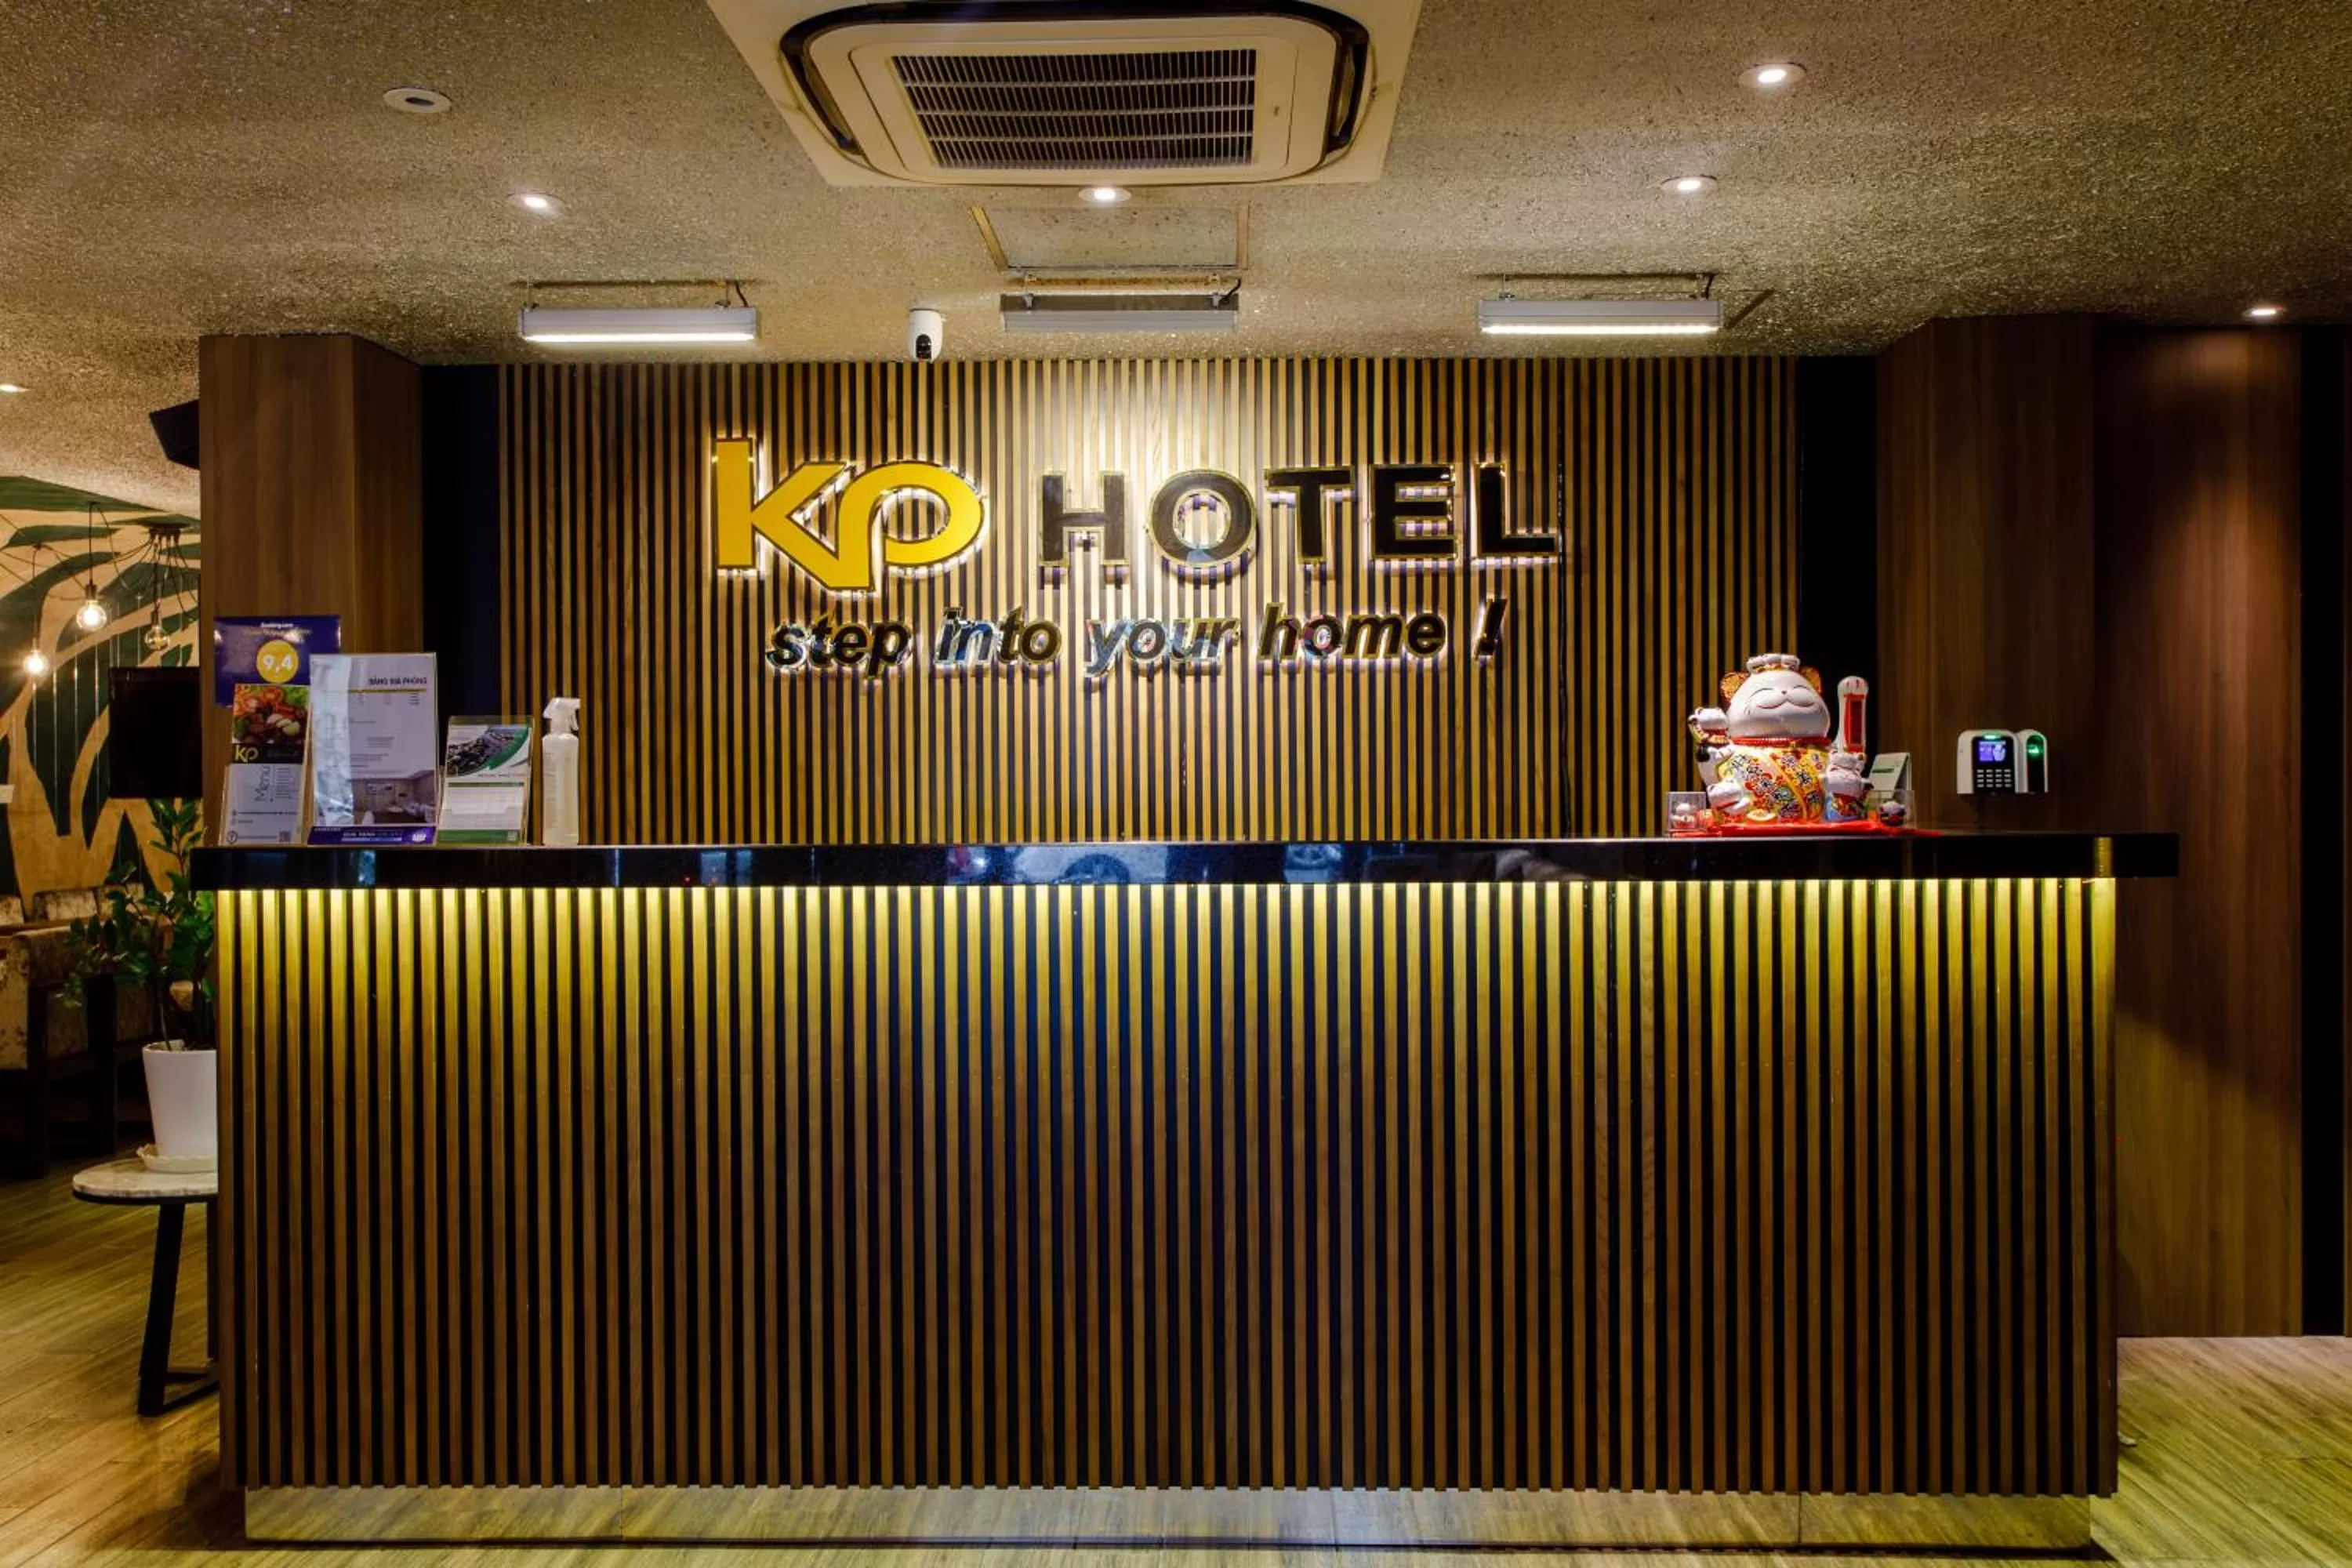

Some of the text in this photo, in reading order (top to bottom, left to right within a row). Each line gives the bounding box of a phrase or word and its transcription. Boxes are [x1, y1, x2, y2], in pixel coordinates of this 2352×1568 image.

[1037, 462, 1559, 568] HOTEL
[766, 607, 913, 679] step
[933, 606, 1062, 665] into
[1083, 616, 1241, 678] your
[1257, 601, 1447, 661] home
